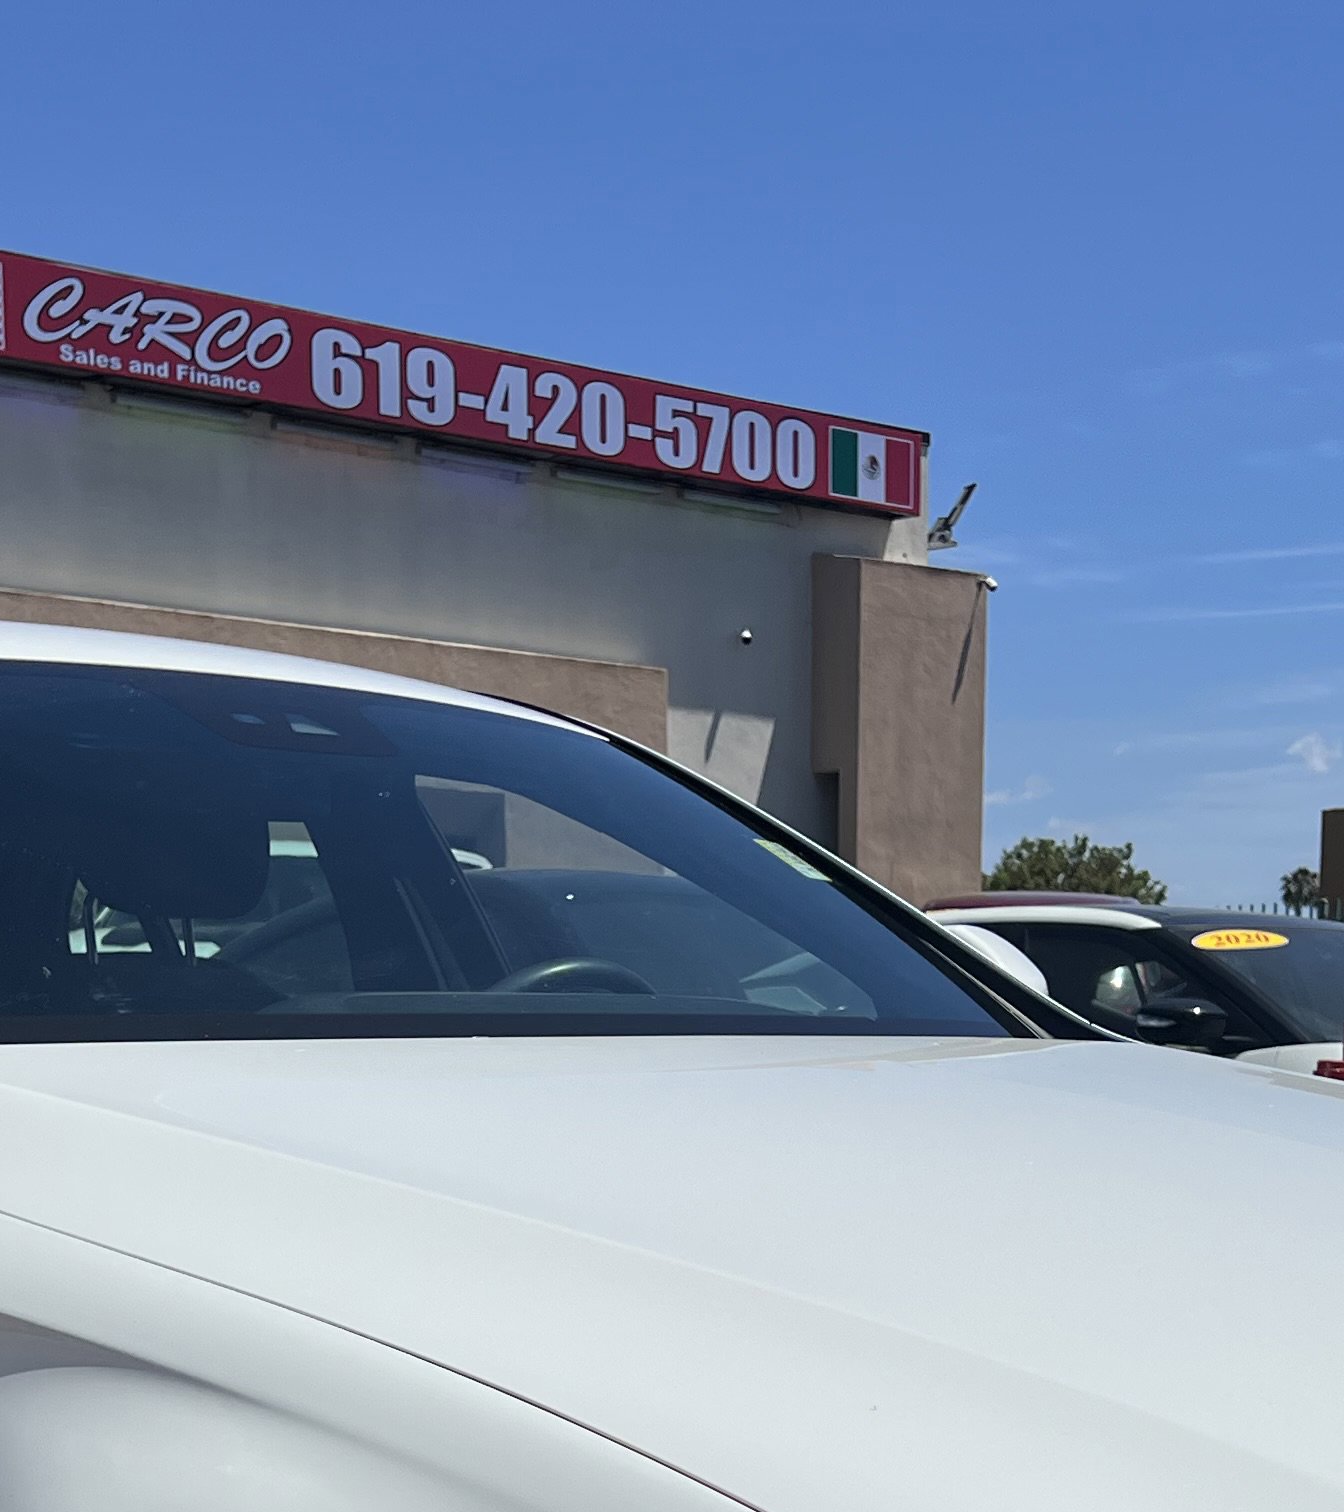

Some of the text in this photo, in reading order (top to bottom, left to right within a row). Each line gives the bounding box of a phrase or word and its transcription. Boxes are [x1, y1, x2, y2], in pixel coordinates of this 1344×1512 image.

[22, 276, 293, 372] CARCO
[59, 342, 261, 394] Sales and Finance
[310, 327, 817, 490] 619-420-5700
[1209, 932, 1270, 948] 2020
